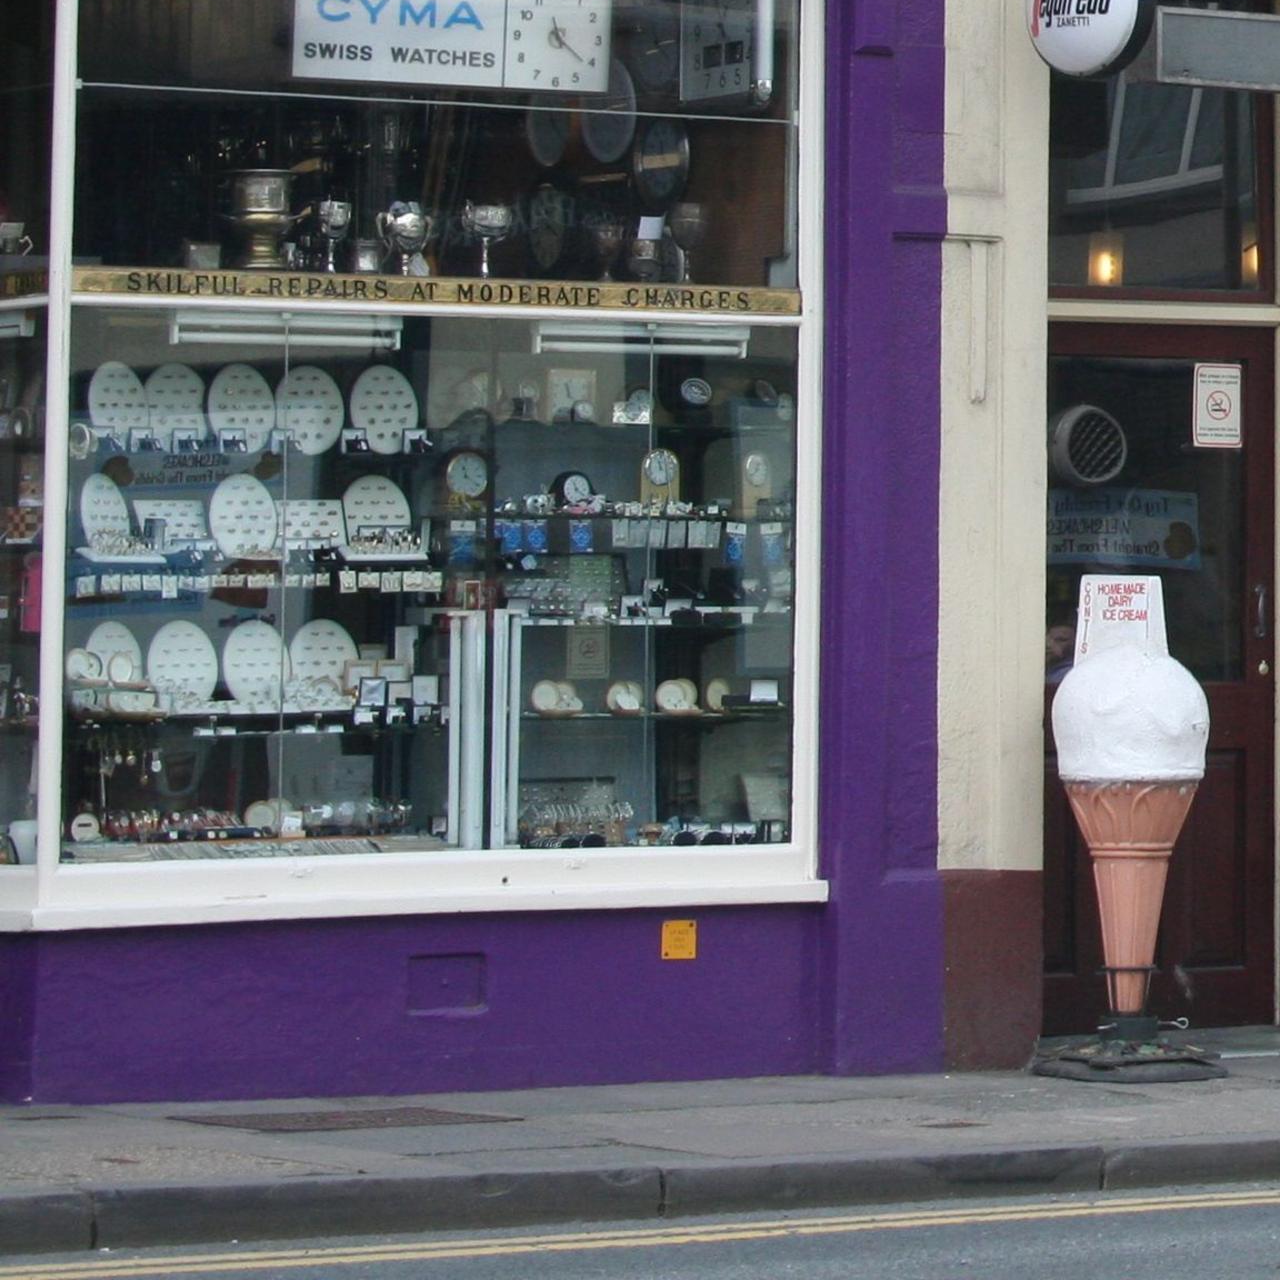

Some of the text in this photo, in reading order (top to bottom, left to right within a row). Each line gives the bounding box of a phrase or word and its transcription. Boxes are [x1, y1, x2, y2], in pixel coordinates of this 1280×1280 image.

[520, 10, 534, 21] 10
[588, 12, 598, 24] 2
[1056, 15, 1091, 28] ZANETTI
[513, 30, 522, 41] 9
[594, 35, 602, 47] 3
[303, 42, 496, 68] SWISS WATCHES
[517, 52, 526, 64] 8
[533, 68, 541, 80] 7
[572, 72, 580, 83] 5
[551, 77, 560, 88] 6
[126, 271, 752, 311] SKILFUL REPAIRS AT MODERATE CHARGES
[1108, 595, 1133, 608] DAIRY
[1102, 608, 1148, 621] ICE CREAM
